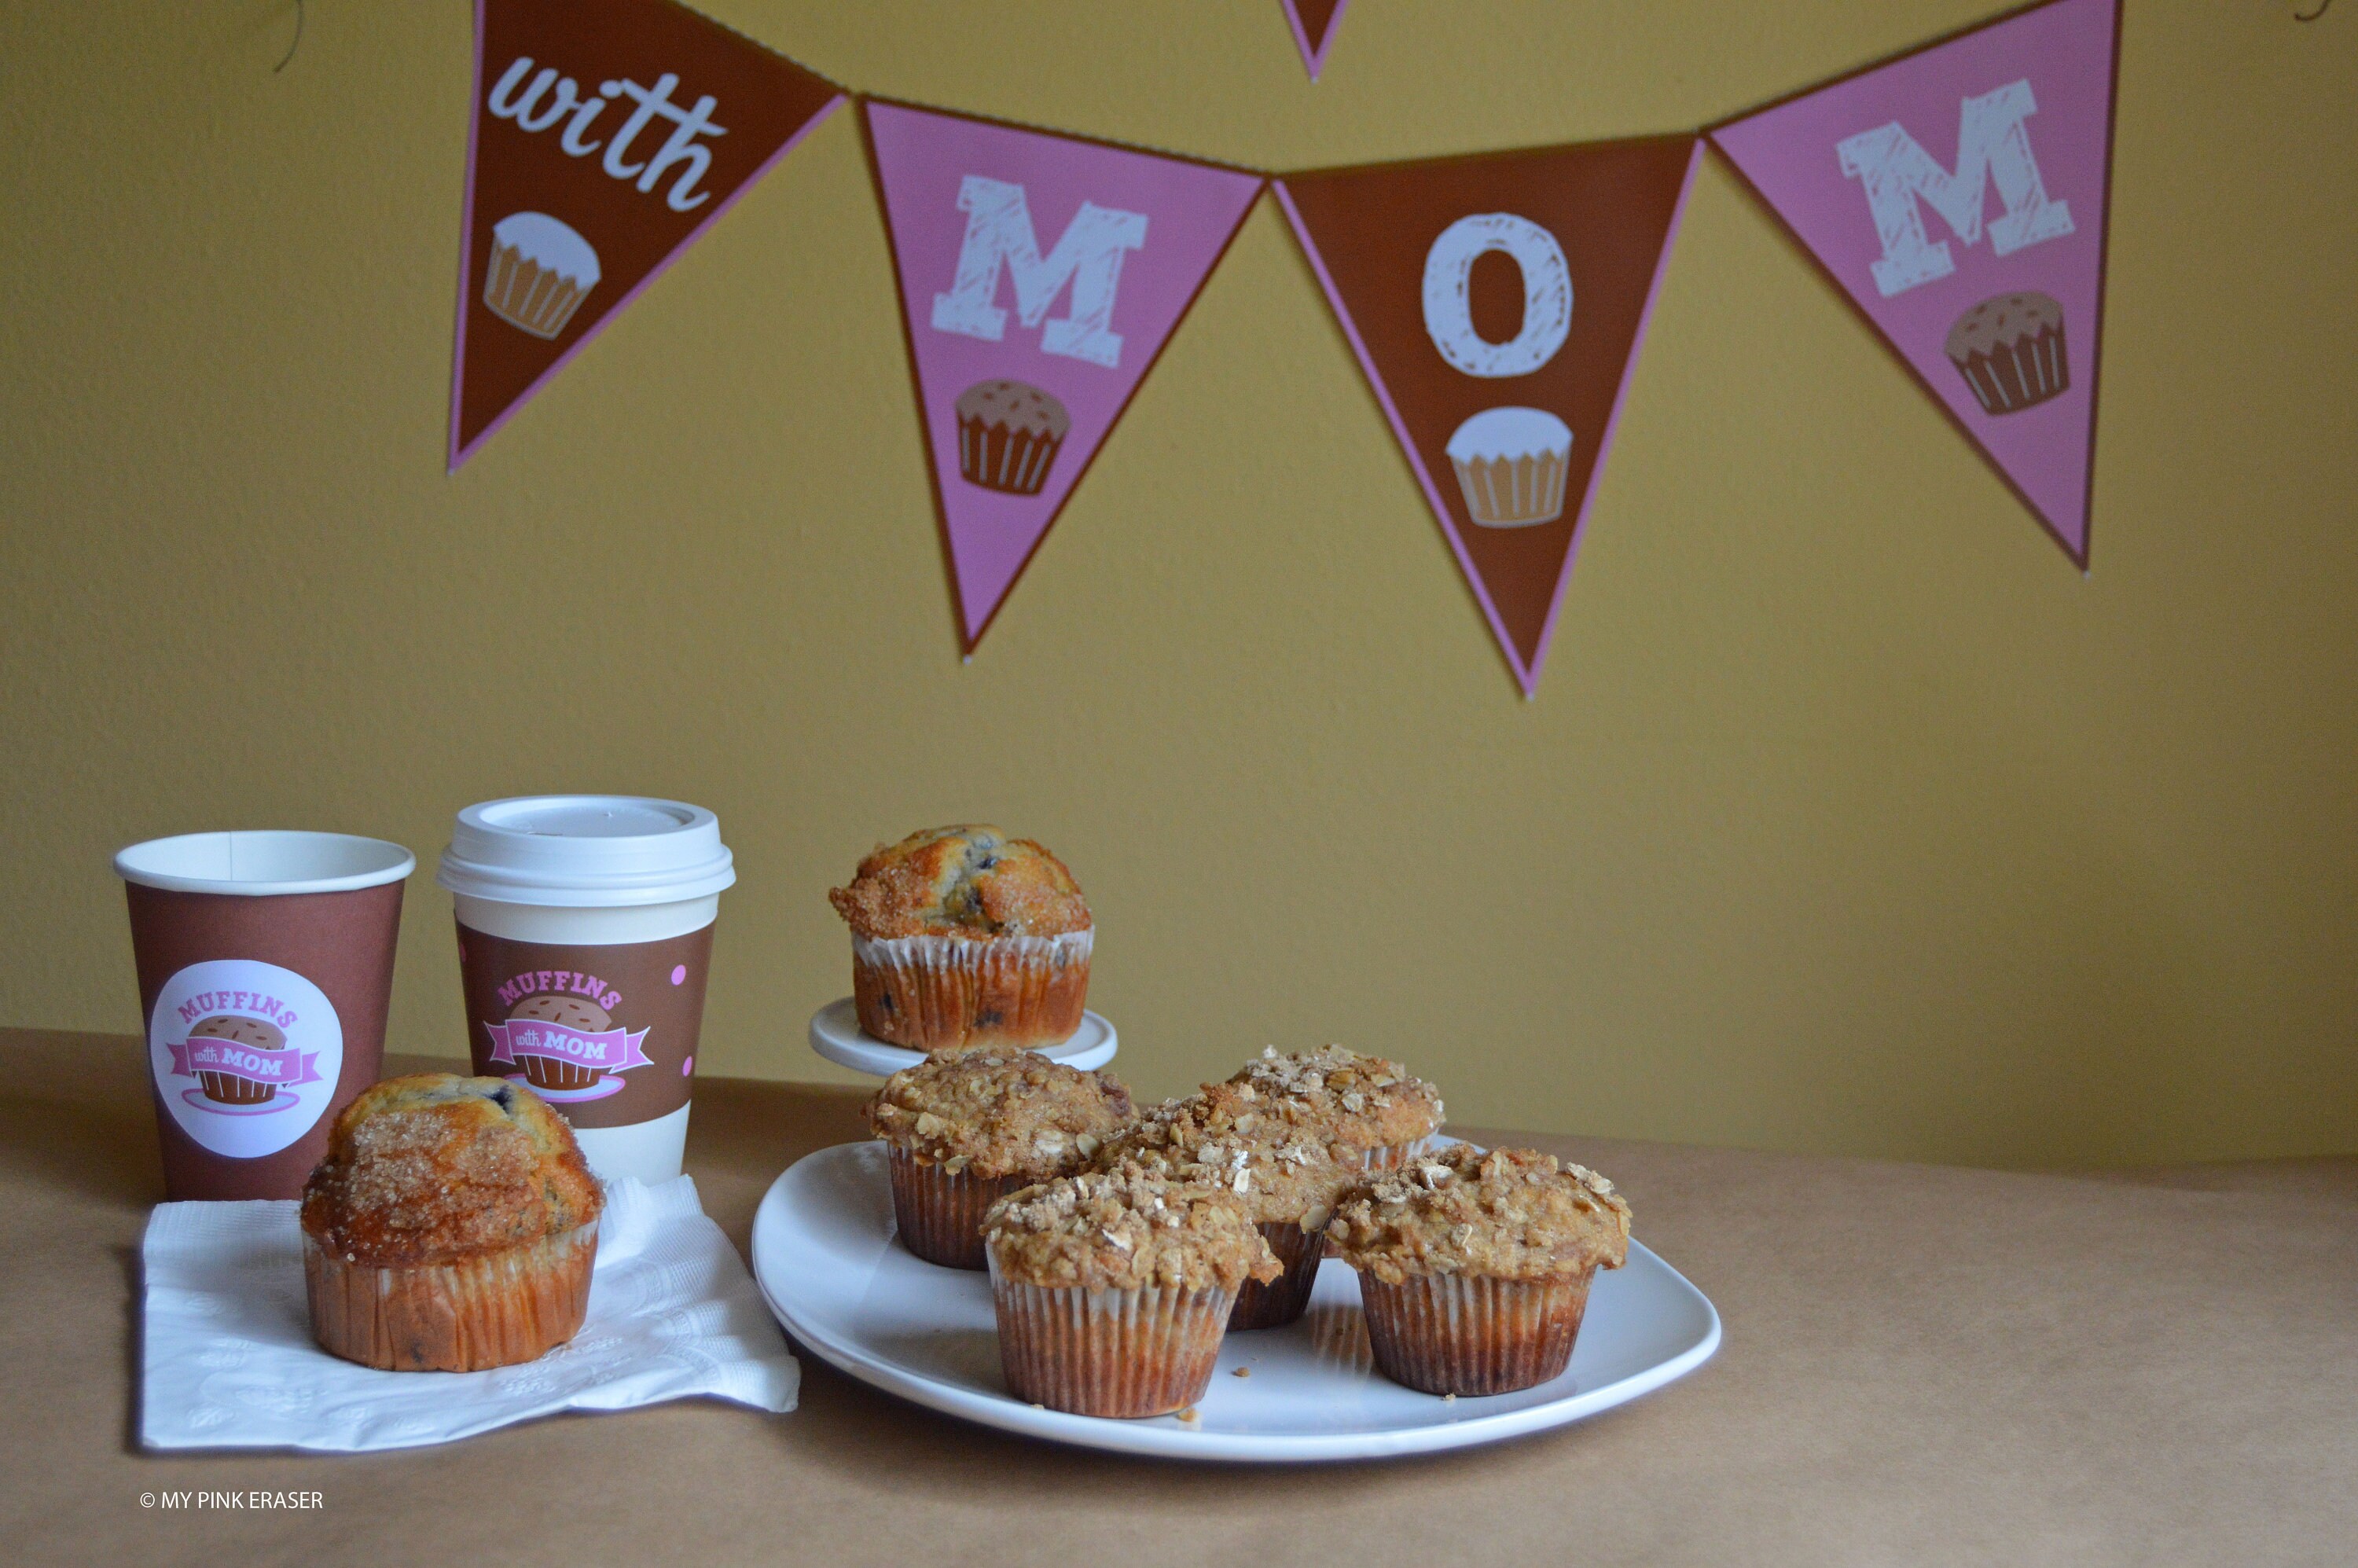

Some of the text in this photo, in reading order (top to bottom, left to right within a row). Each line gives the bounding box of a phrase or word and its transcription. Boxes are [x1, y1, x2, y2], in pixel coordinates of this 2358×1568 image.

[488, 57, 728, 211] with
[1835, 79, 2076, 297] M
[931, 174, 1148, 369] M
[1422, 211, 1573, 378] O
[178, 991, 299, 1028] MUFFINS
[498, 971, 623, 1011] MUFFINS
[195, 1046, 283, 1076] with MOM
[516, 1029, 607, 1059] with MOM
